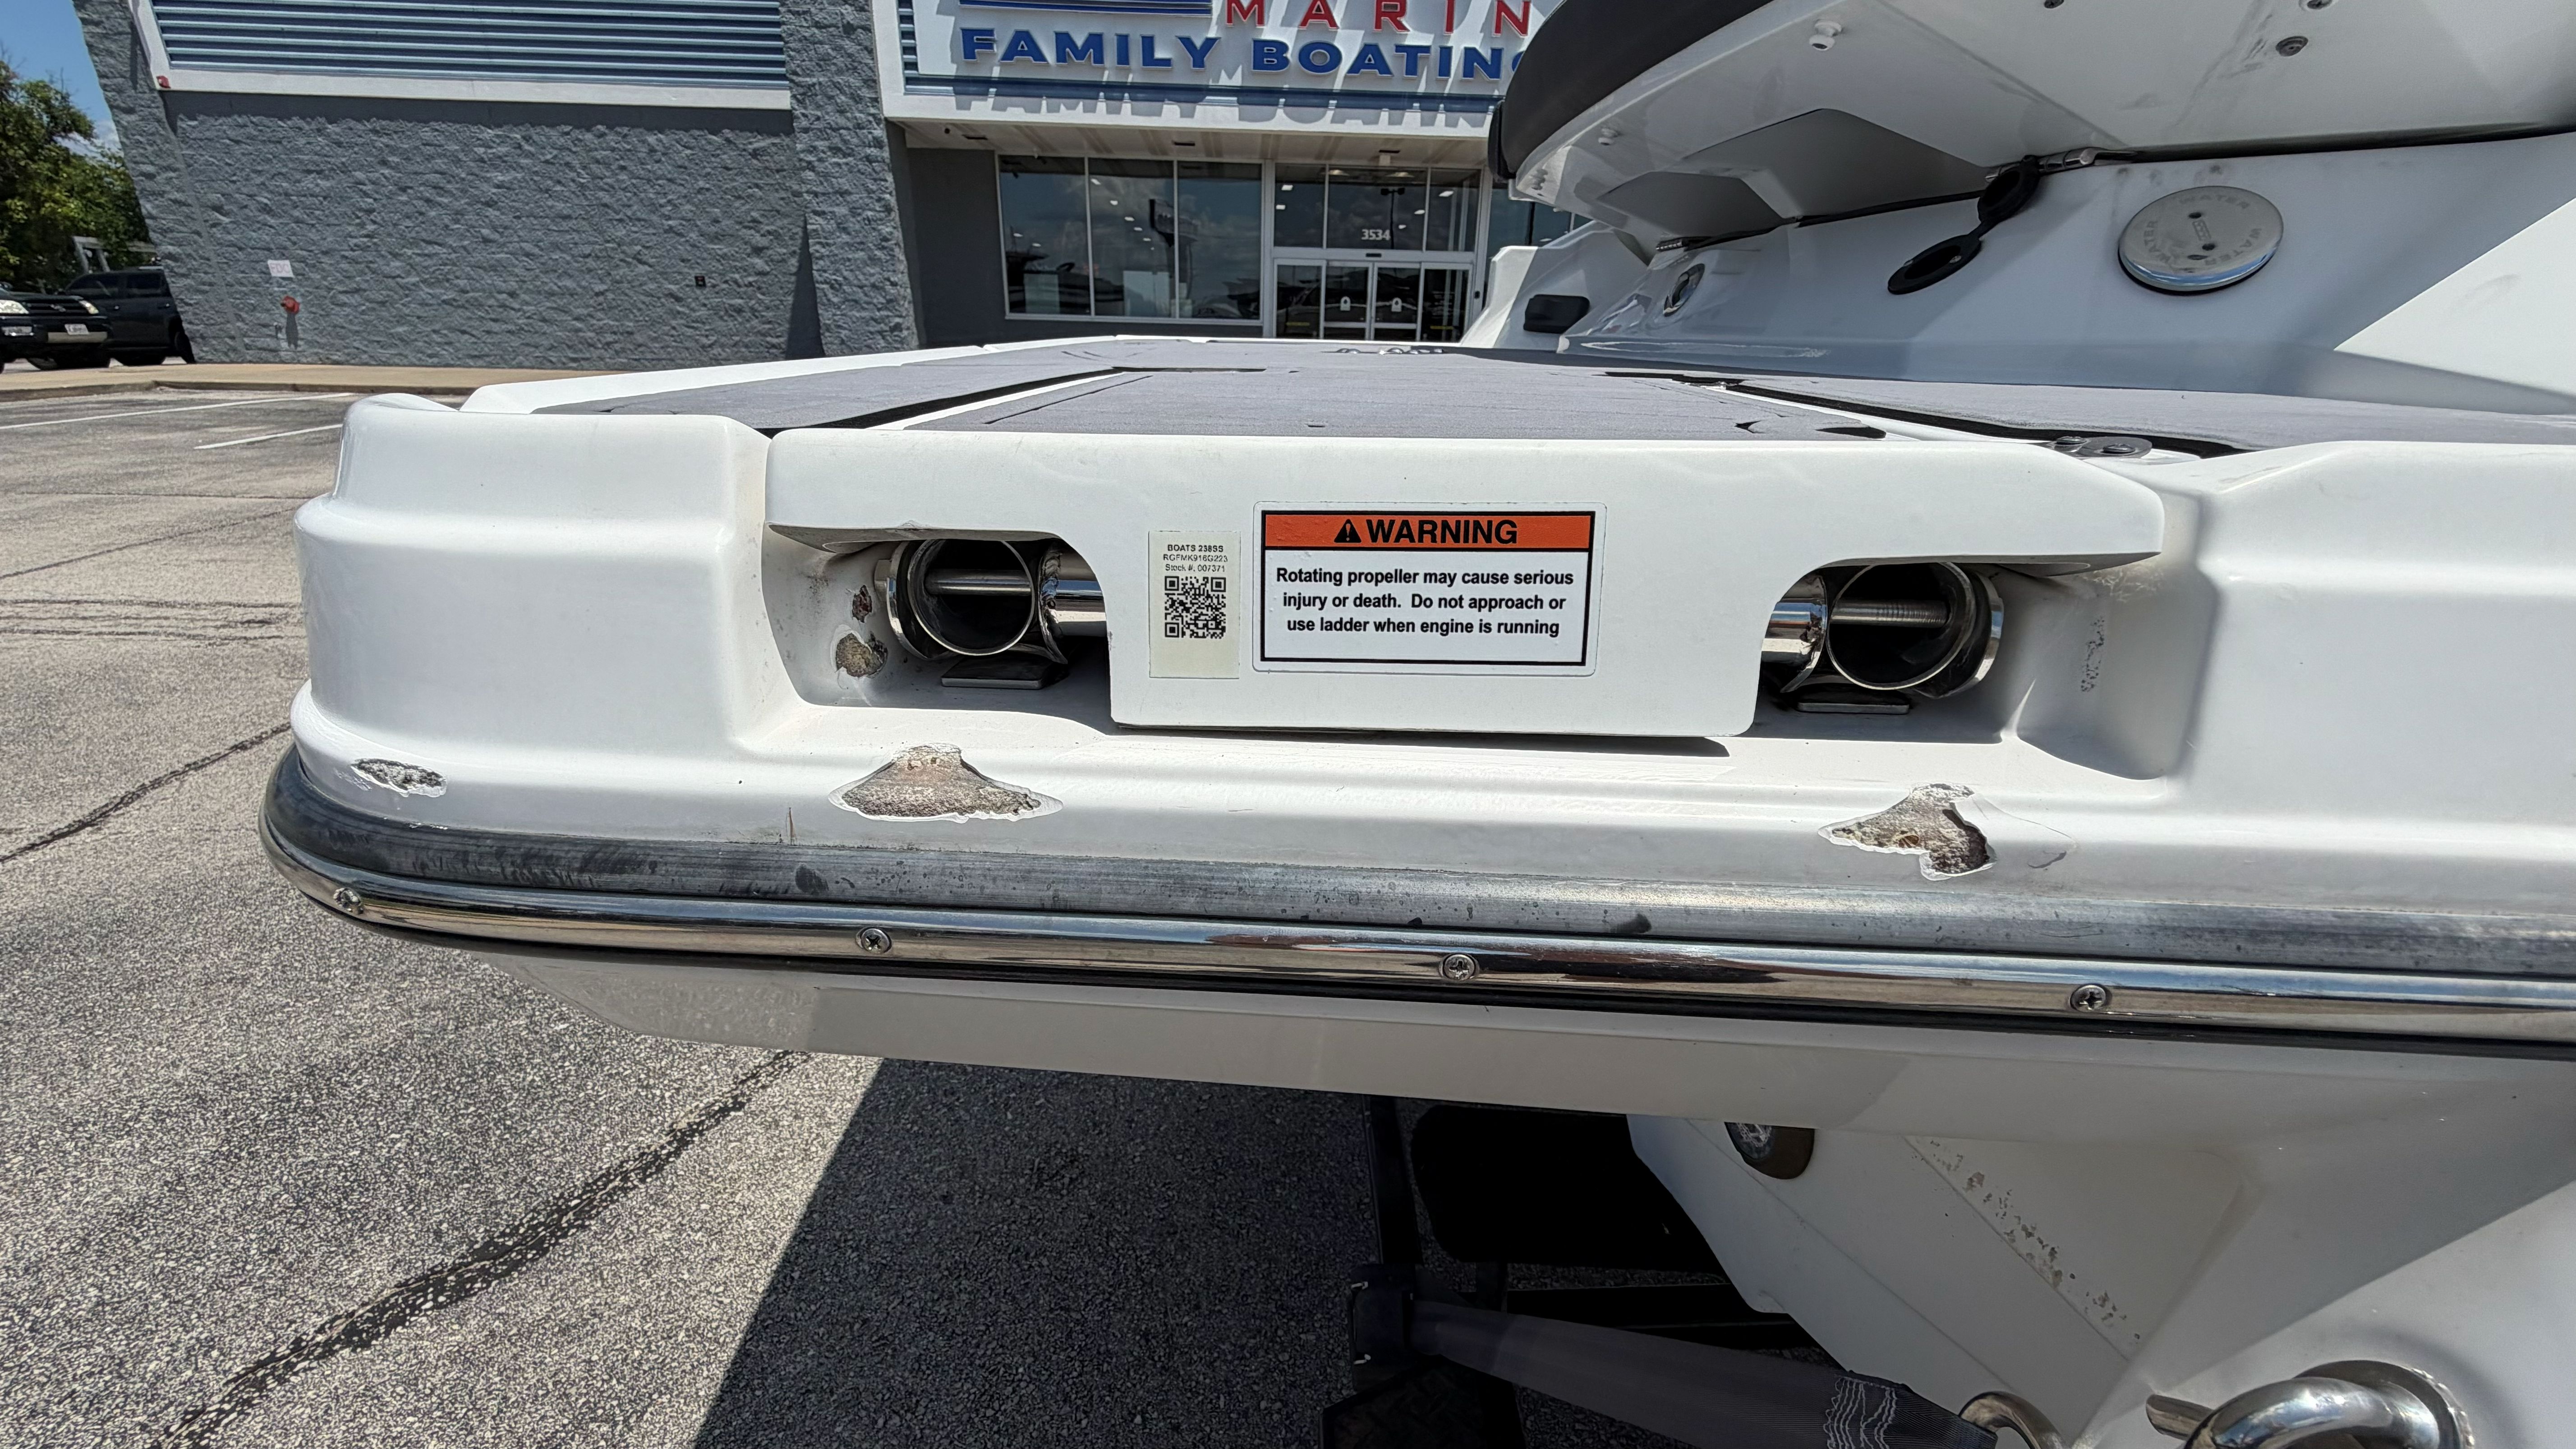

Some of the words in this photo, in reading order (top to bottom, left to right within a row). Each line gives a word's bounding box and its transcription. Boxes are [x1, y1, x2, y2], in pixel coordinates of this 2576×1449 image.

[1226, 0, 1532, 37] MARIN
[961, 27, 1221, 70] FAMILY
[1252, 39, 1528, 80] BOATIN
[2179, 194, 2250, 209] WATER
[1361, 229, 1391, 241] 3534
[2144, 220, 2171, 264] WATER
[2204, 228, 2262, 266] WATER
[1366, 519, 1518, 544] WARNING
[1165, 563, 1186, 571] Stock
[1197, 564, 1225, 572] 007371
[1276, 567, 1343, 586] Rotating
[1347, 568, 1420, 587] propeller
[1423, 572, 1458, 588] may
[1461, 572, 1510, 585] cause
[1513, 569, 1574, 586] serious
[1283, 592, 1328, 612] injury
[1331, 596, 1350, 608] or
[1352, 593, 1402, 608] death.
[1410, 593, 1434, 609] Do
[1438, 594, 1465, 609] not
[1467, 594, 1544, 613] approach
[1548, 598, 1567, 611] or
[1286, 619, 1316, 632] use
[1320, 616, 1371, 633] ladder
[1373, 617, 1416, 633] when
[1419, 618, 1474, 637] engine
[1478, 619, 1493, 635] is
[1496, 619, 1560, 638] running
